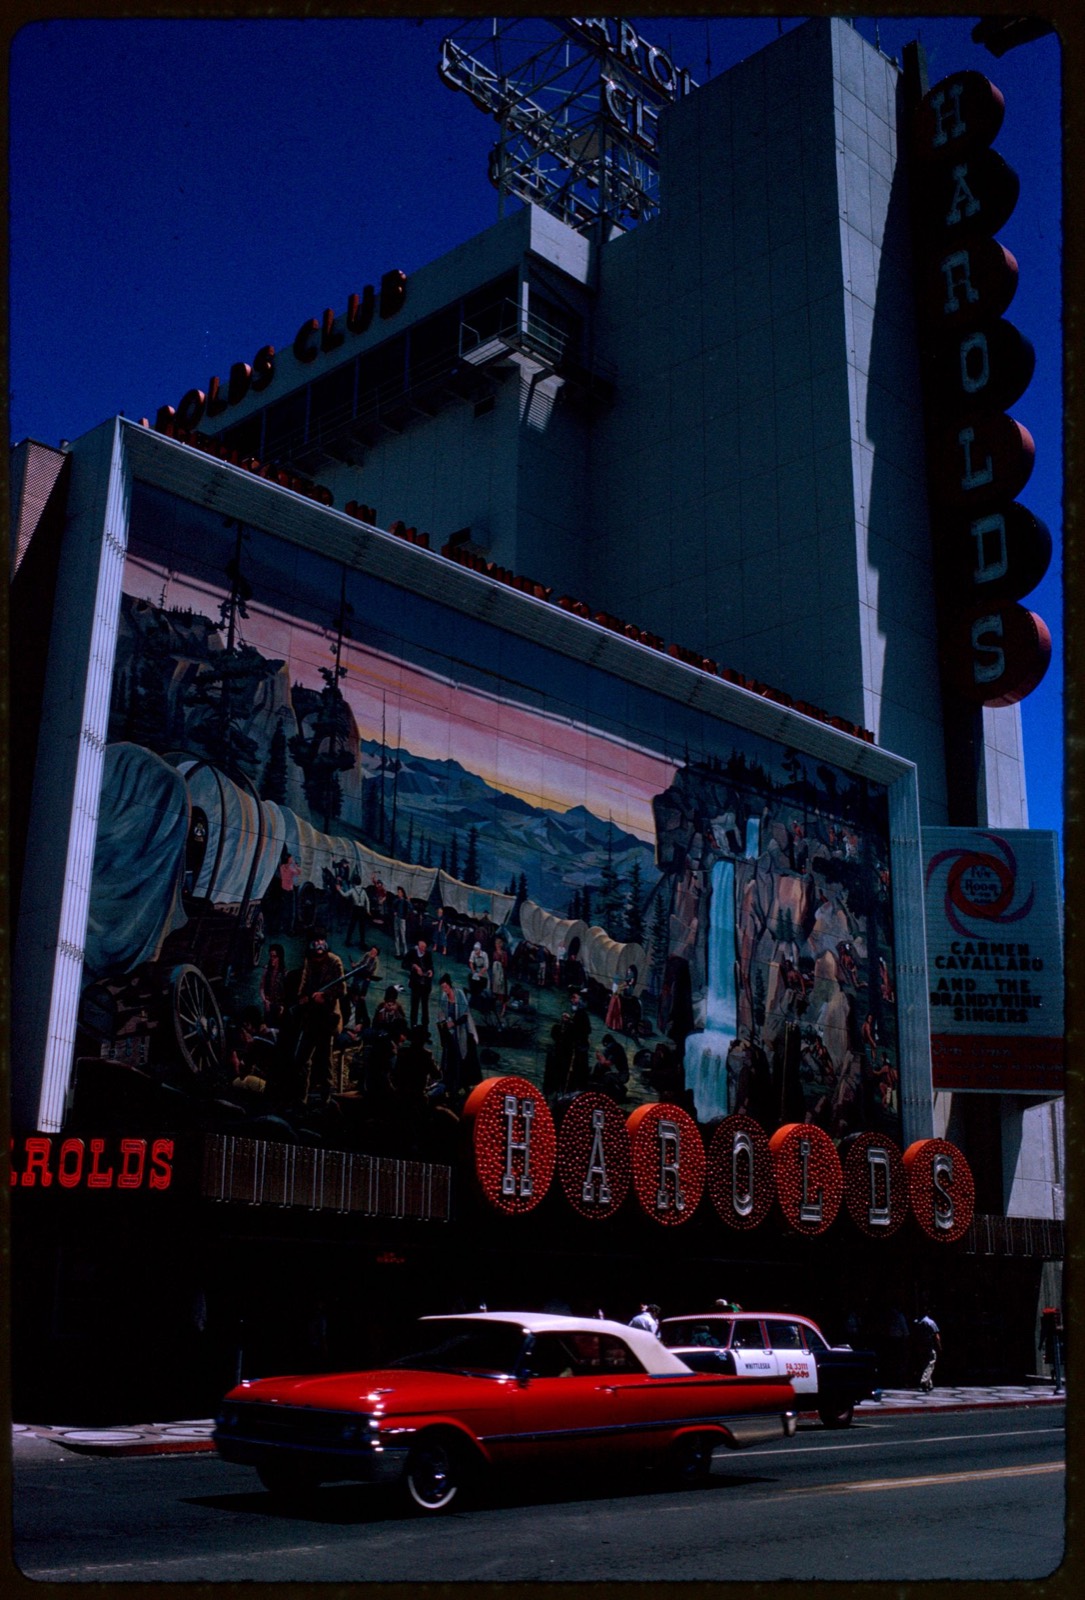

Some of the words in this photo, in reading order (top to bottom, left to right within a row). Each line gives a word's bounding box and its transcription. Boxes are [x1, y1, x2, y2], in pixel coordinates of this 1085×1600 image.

[293, 269, 408, 363] CLUB
[930, 82, 1008, 686] HAROLDS
[949, 941, 1030, 957] CARMEN
[934, 955, 1044, 972] CAVALLARO
[936, 977, 976, 992] AND
[997, 978, 1032, 994] THE
[930, 992, 1043, 1009] BRANDYWINE
[953, 1007, 1029, 1024] SINGERS
[501, 1093, 956, 1231] HAROLDS
